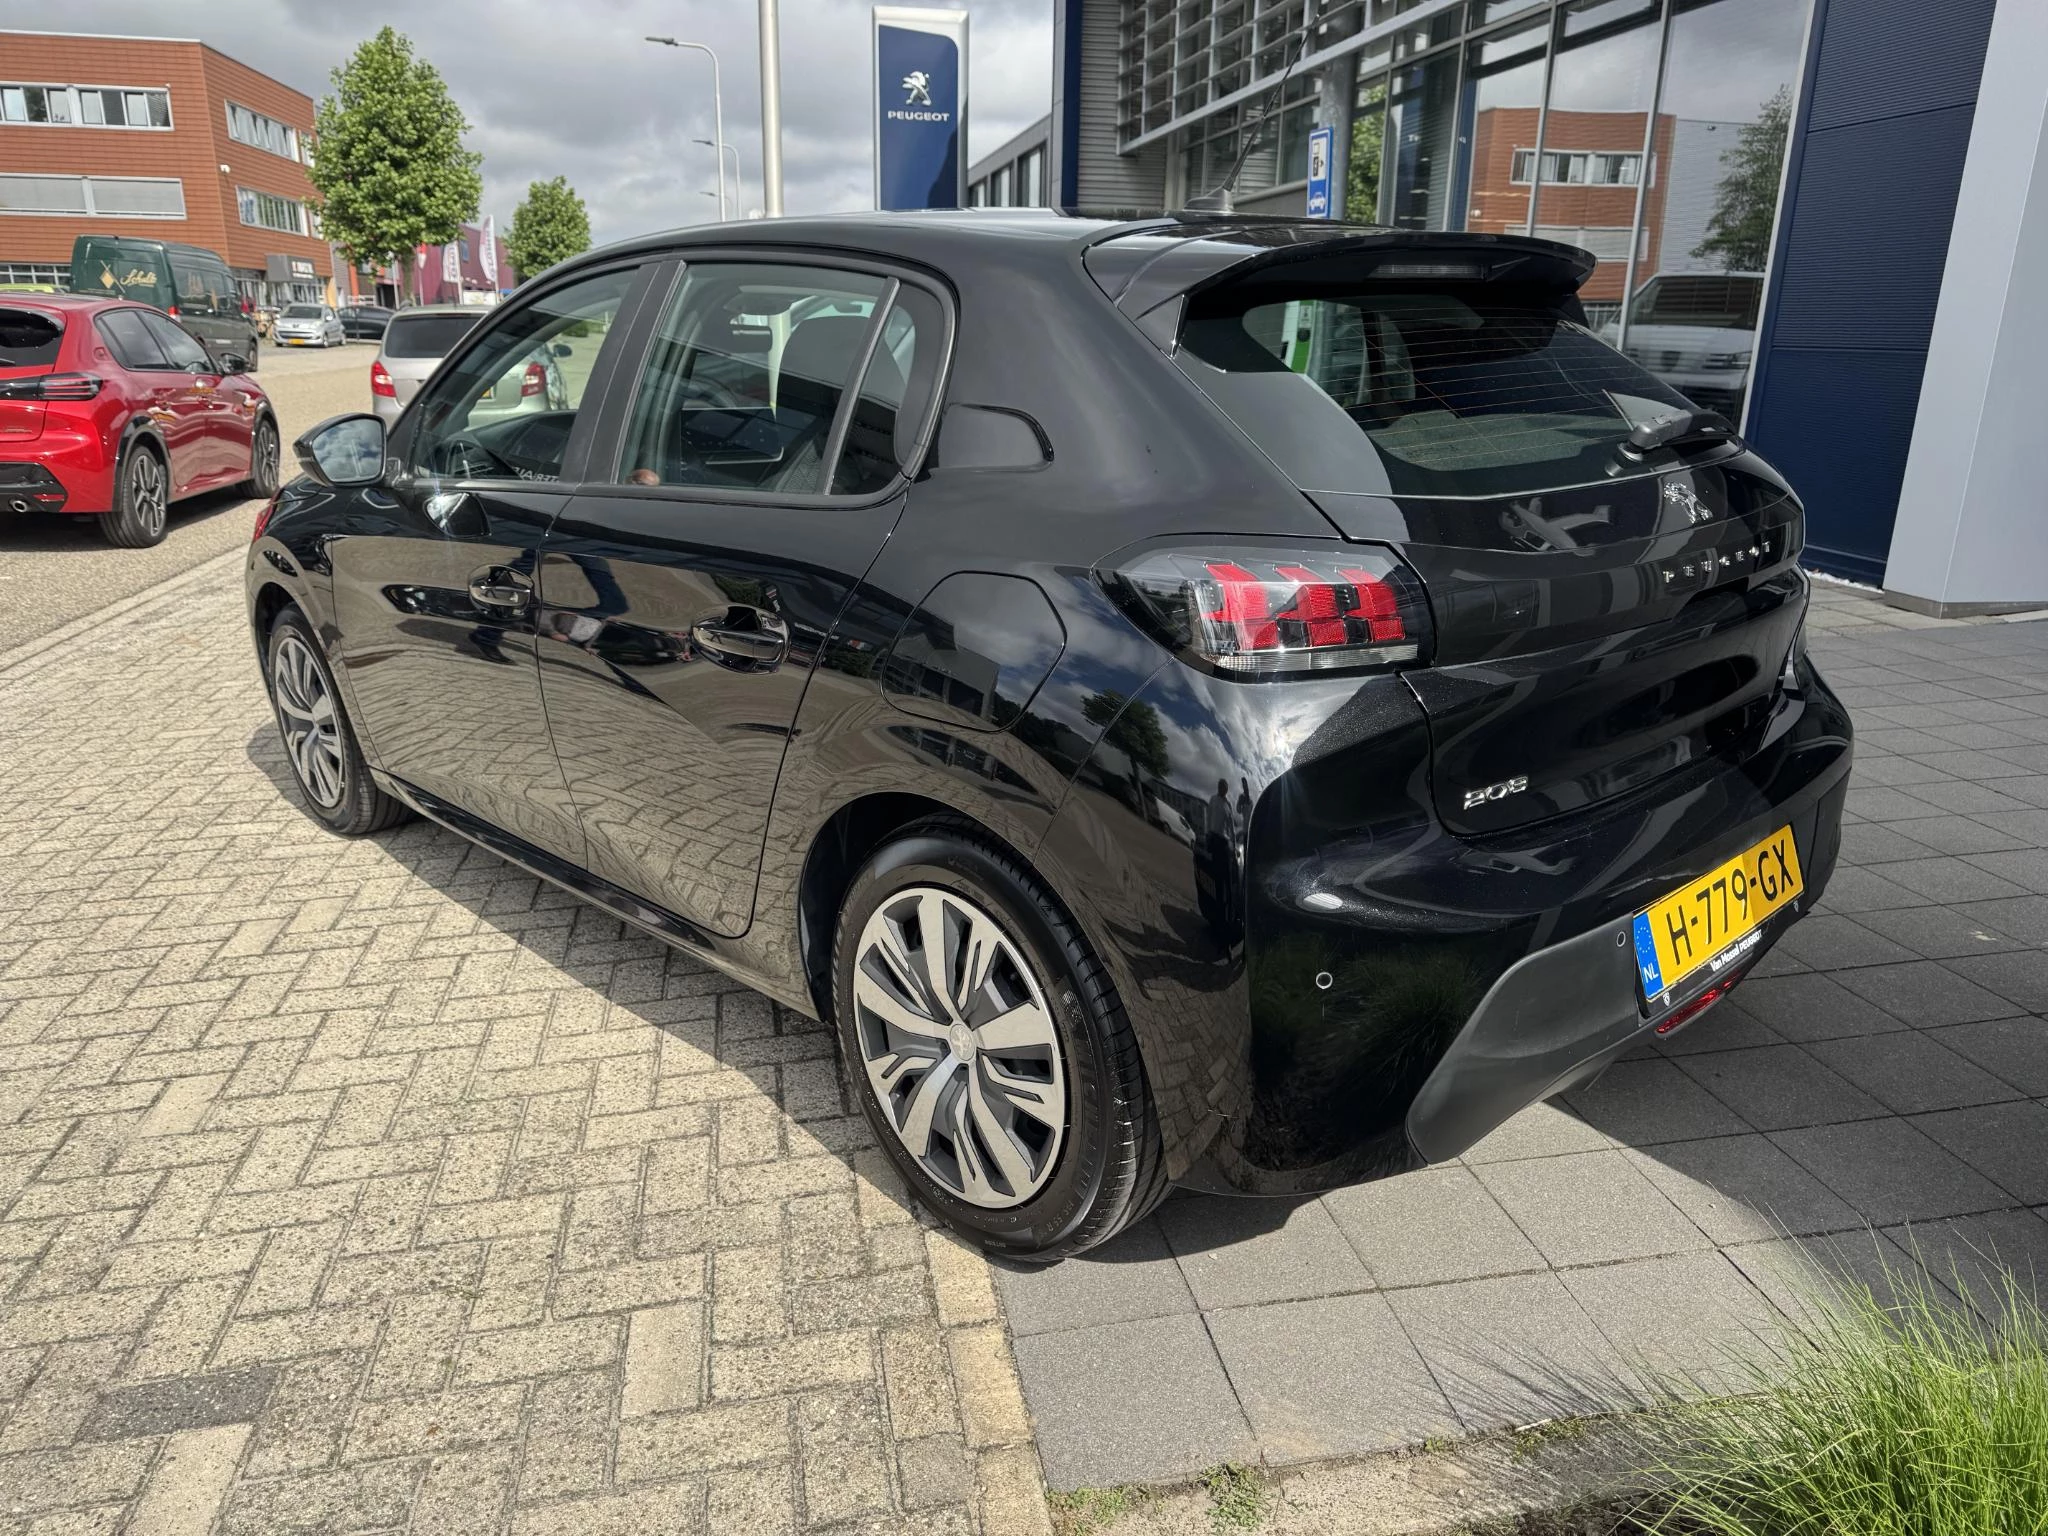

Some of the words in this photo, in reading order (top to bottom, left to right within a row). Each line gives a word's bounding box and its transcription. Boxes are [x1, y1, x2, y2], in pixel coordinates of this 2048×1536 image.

[887, 110, 950, 122] PEUGEOT
[1663, 541, 1770, 583] PEUGEOT
[1463, 776, 1528, 810] 208
[1666, 839, 1794, 966] H-779-GX
[1710, 960, 1722, 972] Van
[1720, 943, 1740, 966] Mossel
[1739, 929, 1762, 952] PEUGEOT
[1643, 962, 1659, 984] NL
